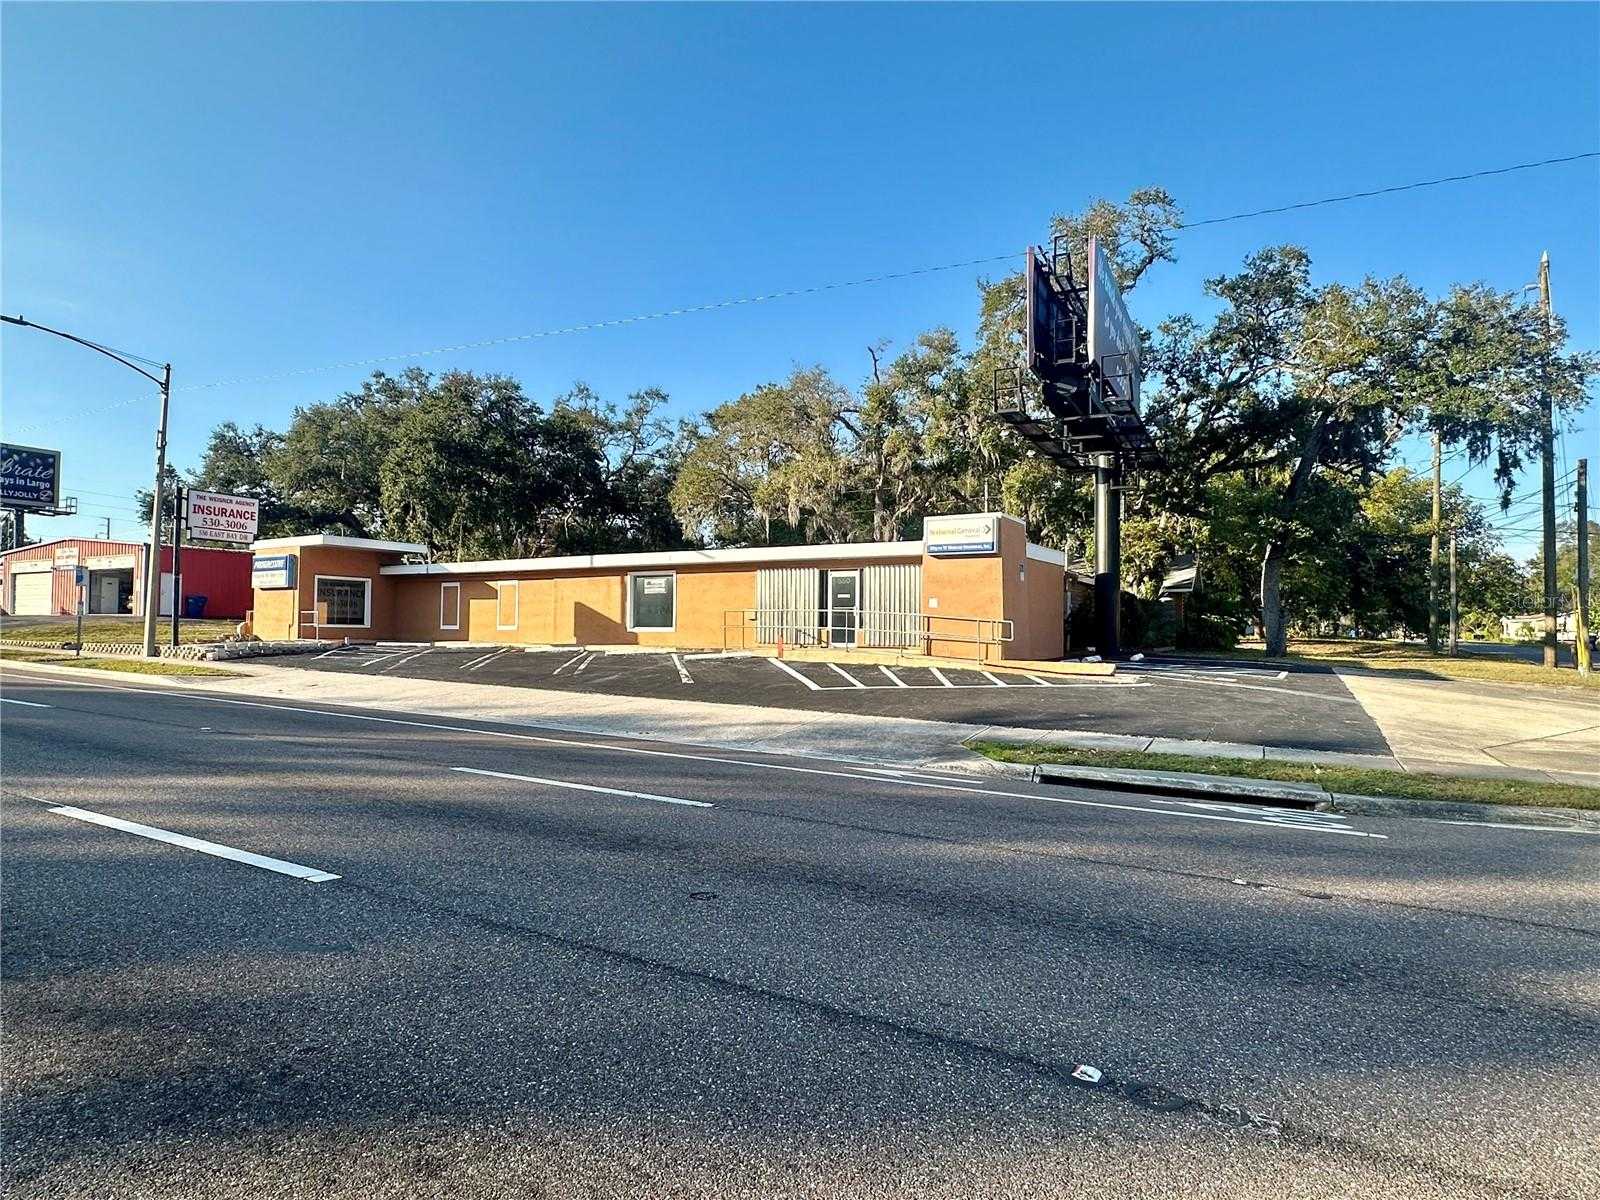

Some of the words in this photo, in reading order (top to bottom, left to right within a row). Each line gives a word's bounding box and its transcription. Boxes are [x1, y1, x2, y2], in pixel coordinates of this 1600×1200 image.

[27, 479, 50, 489] Largo
[192, 504, 257, 521] INSURANCE
[202, 518, 247, 530] 530-3006
